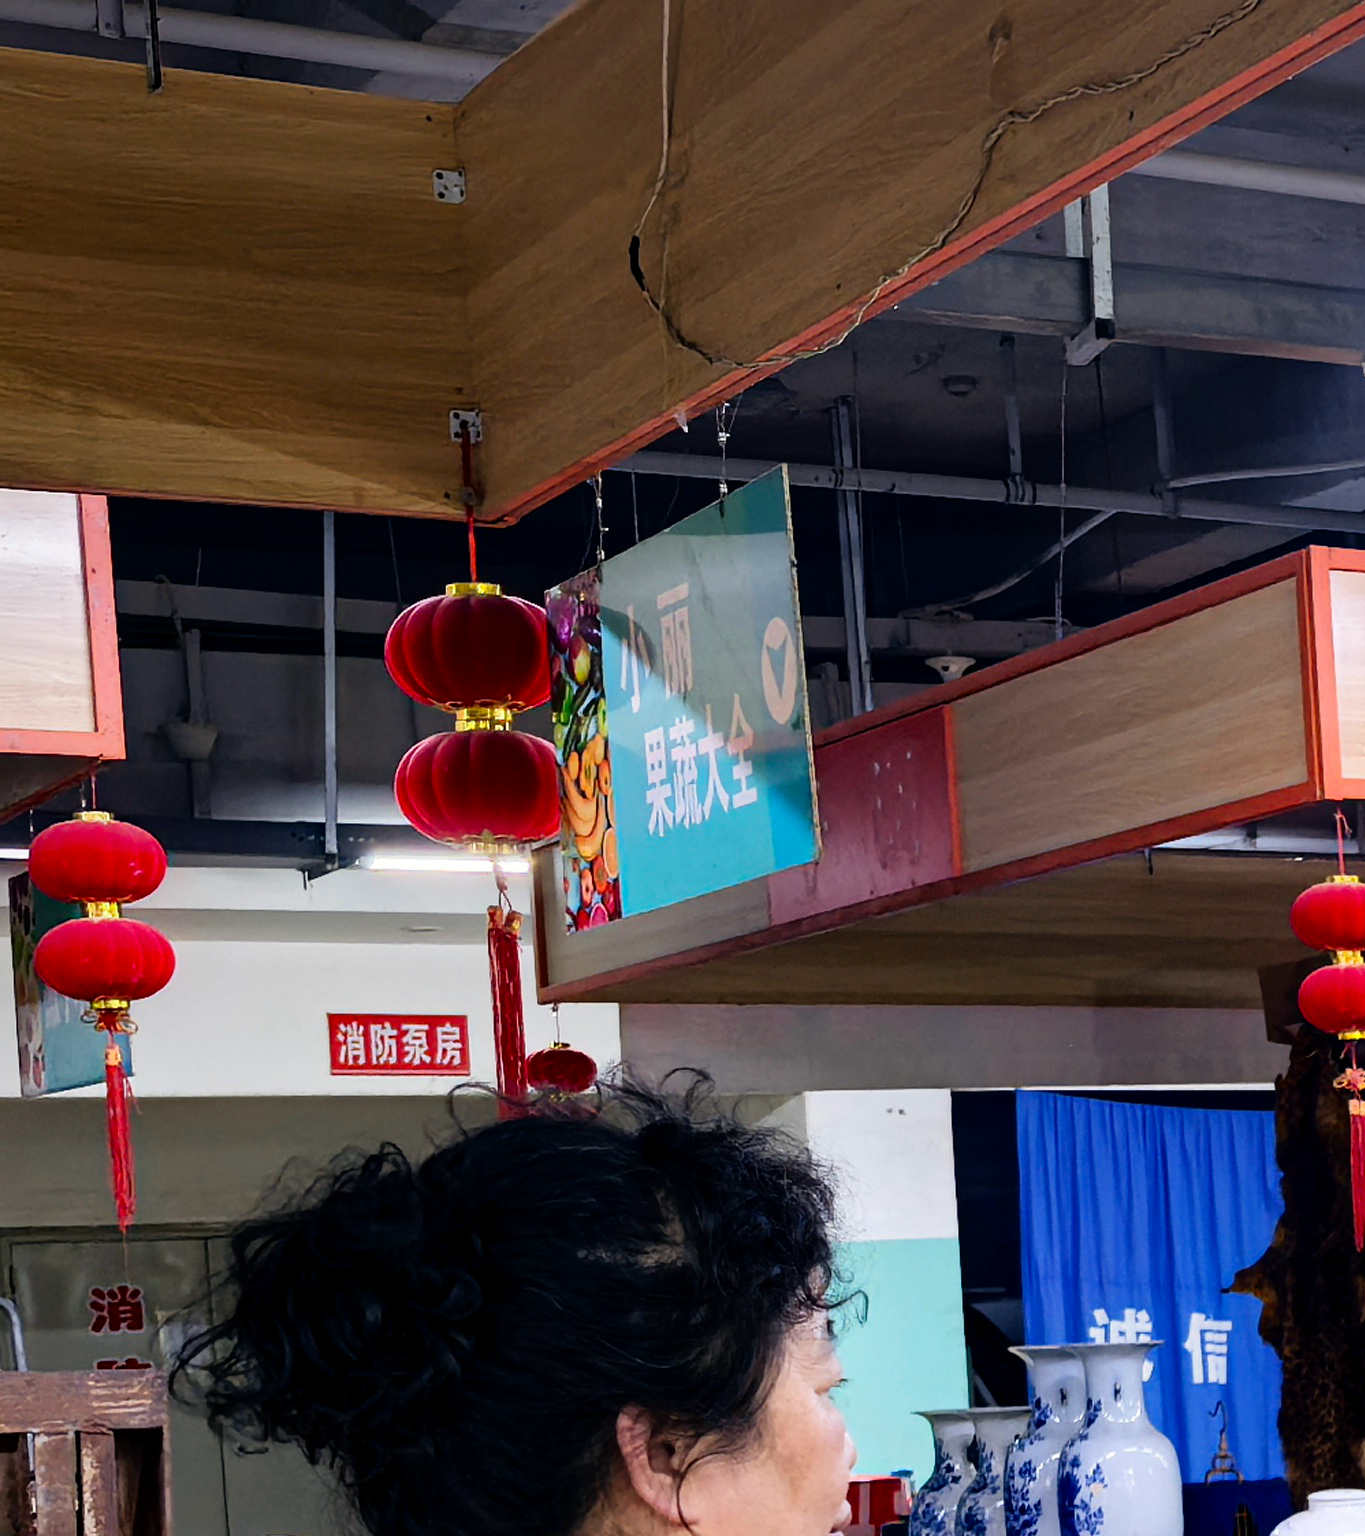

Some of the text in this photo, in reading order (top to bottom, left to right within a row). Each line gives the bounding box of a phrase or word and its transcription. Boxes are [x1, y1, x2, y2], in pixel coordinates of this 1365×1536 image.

[621, 582, 693, 713] 小丽
[644, 693, 758, 838] 果蔬大全
[336, 1021, 462, 1065] 消防泵房
